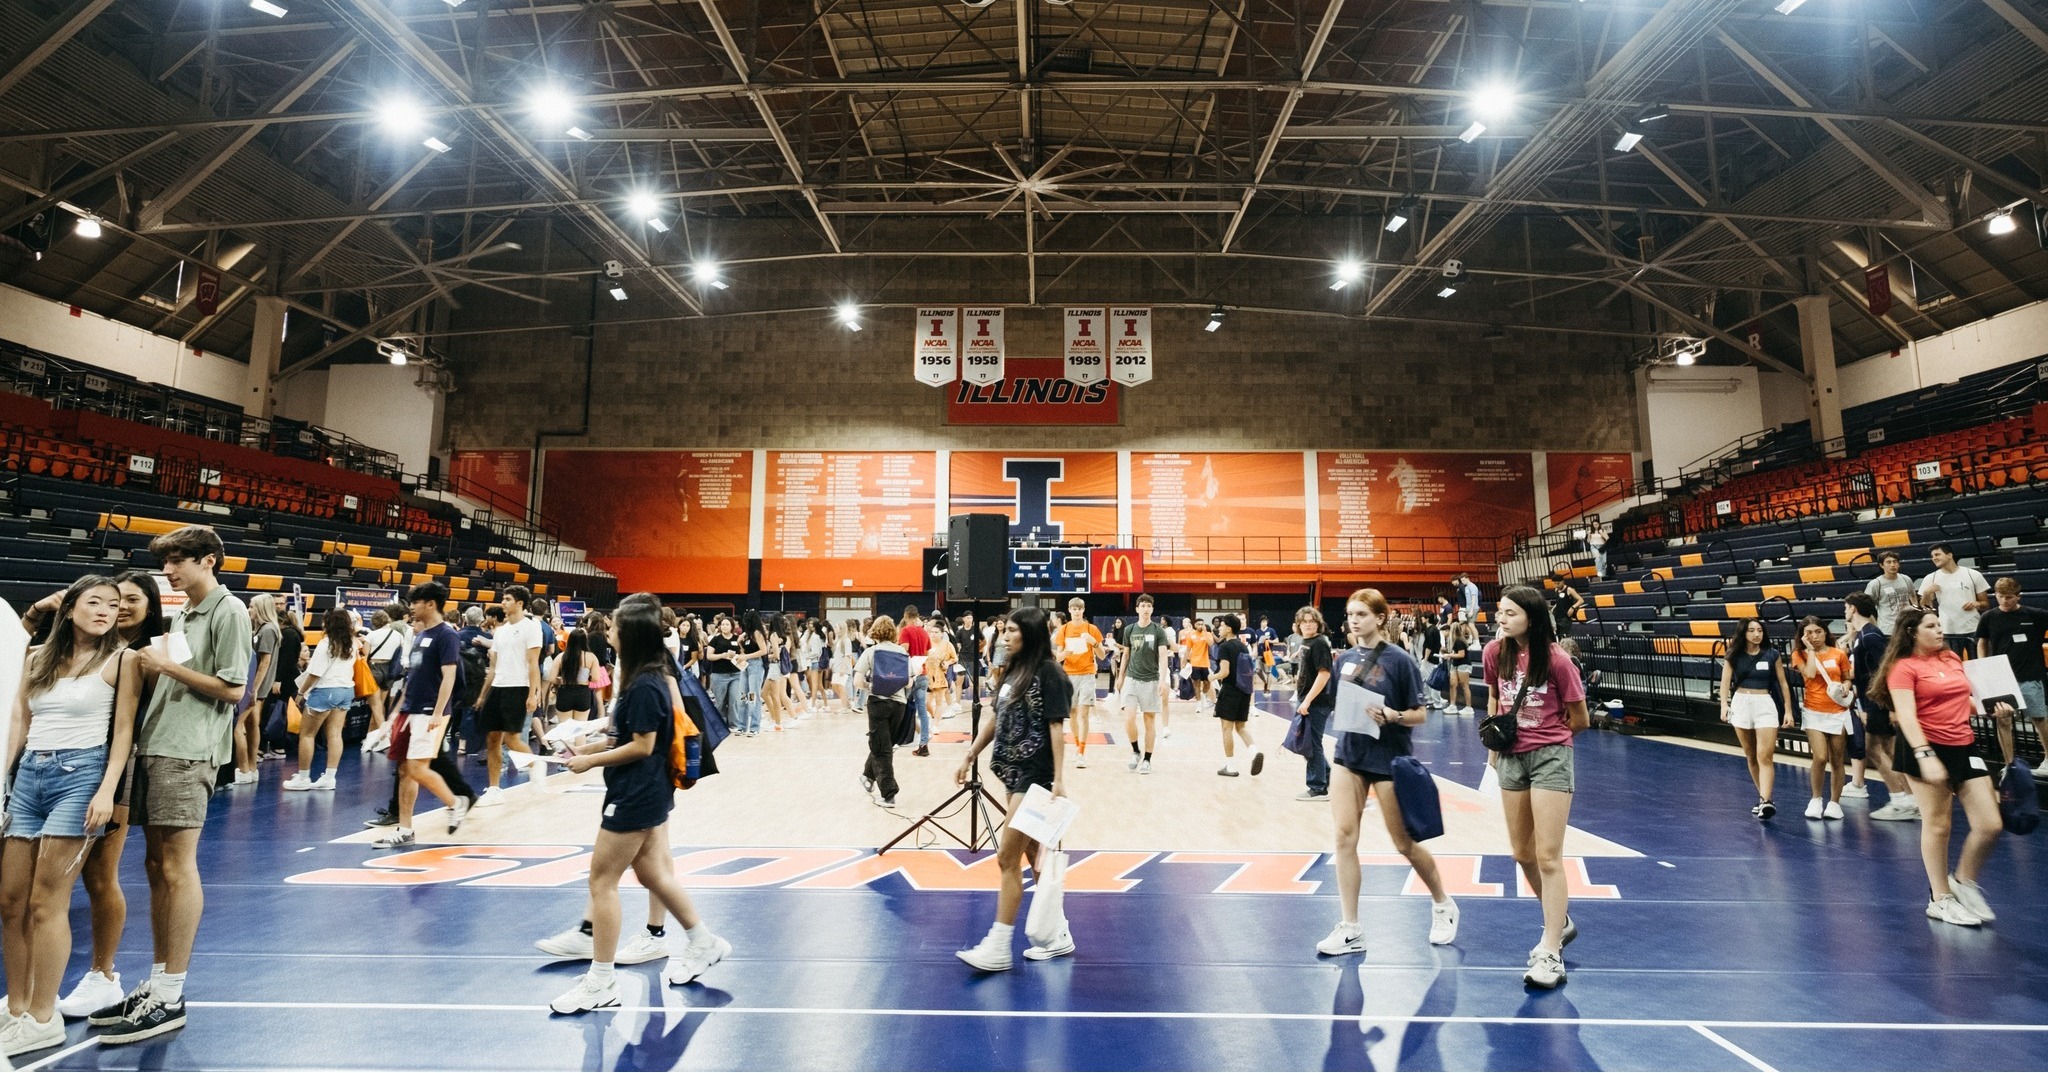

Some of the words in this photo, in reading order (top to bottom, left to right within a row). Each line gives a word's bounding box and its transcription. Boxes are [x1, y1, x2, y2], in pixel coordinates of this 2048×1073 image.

[931, 319, 943, 336] I
[977, 319, 990, 336] I
[1078, 319, 1091, 336] I
[1124, 319, 1137, 336] I
[920, 356, 951, 365] 1956
[967, 356, 998, 365] 1958
[1069, 356, 1100, 365] 1989
[1116, 356, 1146, 365] 2012
[30, 362, 45, 372] 212
[2040, 366, 2048, 374] 20
[86, 377, 99, 386] 213
[956, 378, 1110, 404] ILLINOIS
[140, 460, 152, 469] 112
[1918, 466, 1931, 475] 103
[1002, 458, 1064, 543] I
